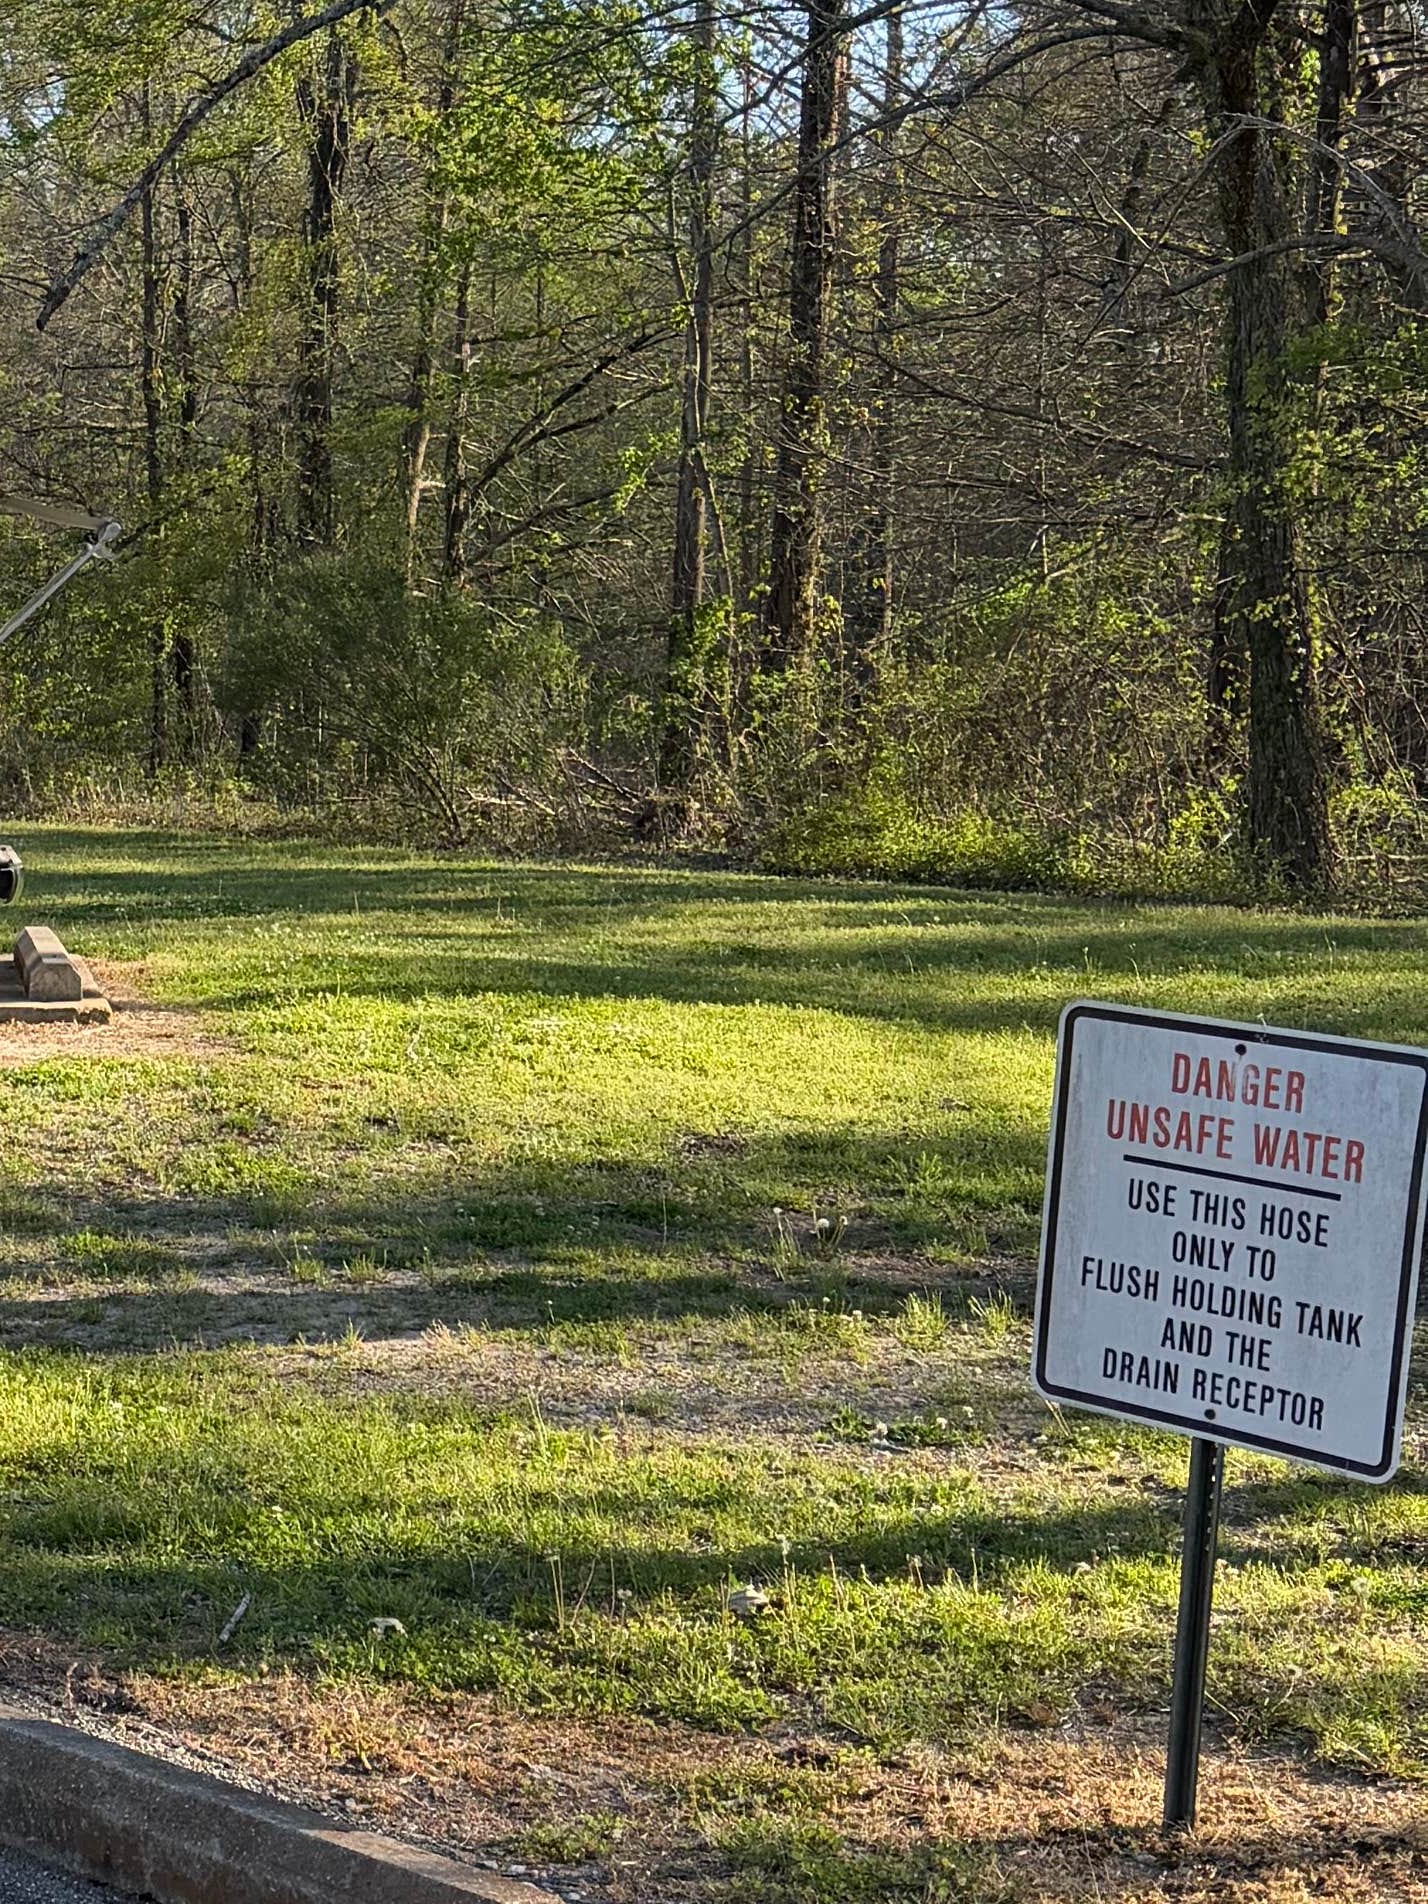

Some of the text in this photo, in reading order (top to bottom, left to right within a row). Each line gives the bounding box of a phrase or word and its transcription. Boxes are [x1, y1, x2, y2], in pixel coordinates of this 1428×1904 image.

[1171, 1052, 1306, 1114] DANGER
[1106, 1098, 1365, 1184] UNSAFE WATER
[1127, 1177, 1331, 1248] USE THIS HOSE
[1171, 1230, 1277, 1282] ONLY TO
[1080, 1255, 1365, 1349] FLUSH HOLDING TANK
[1160, 1316, 1273, 1373] AND THE
[1101, 1346, 1326, 1432] DRAIN RECEPTOR
